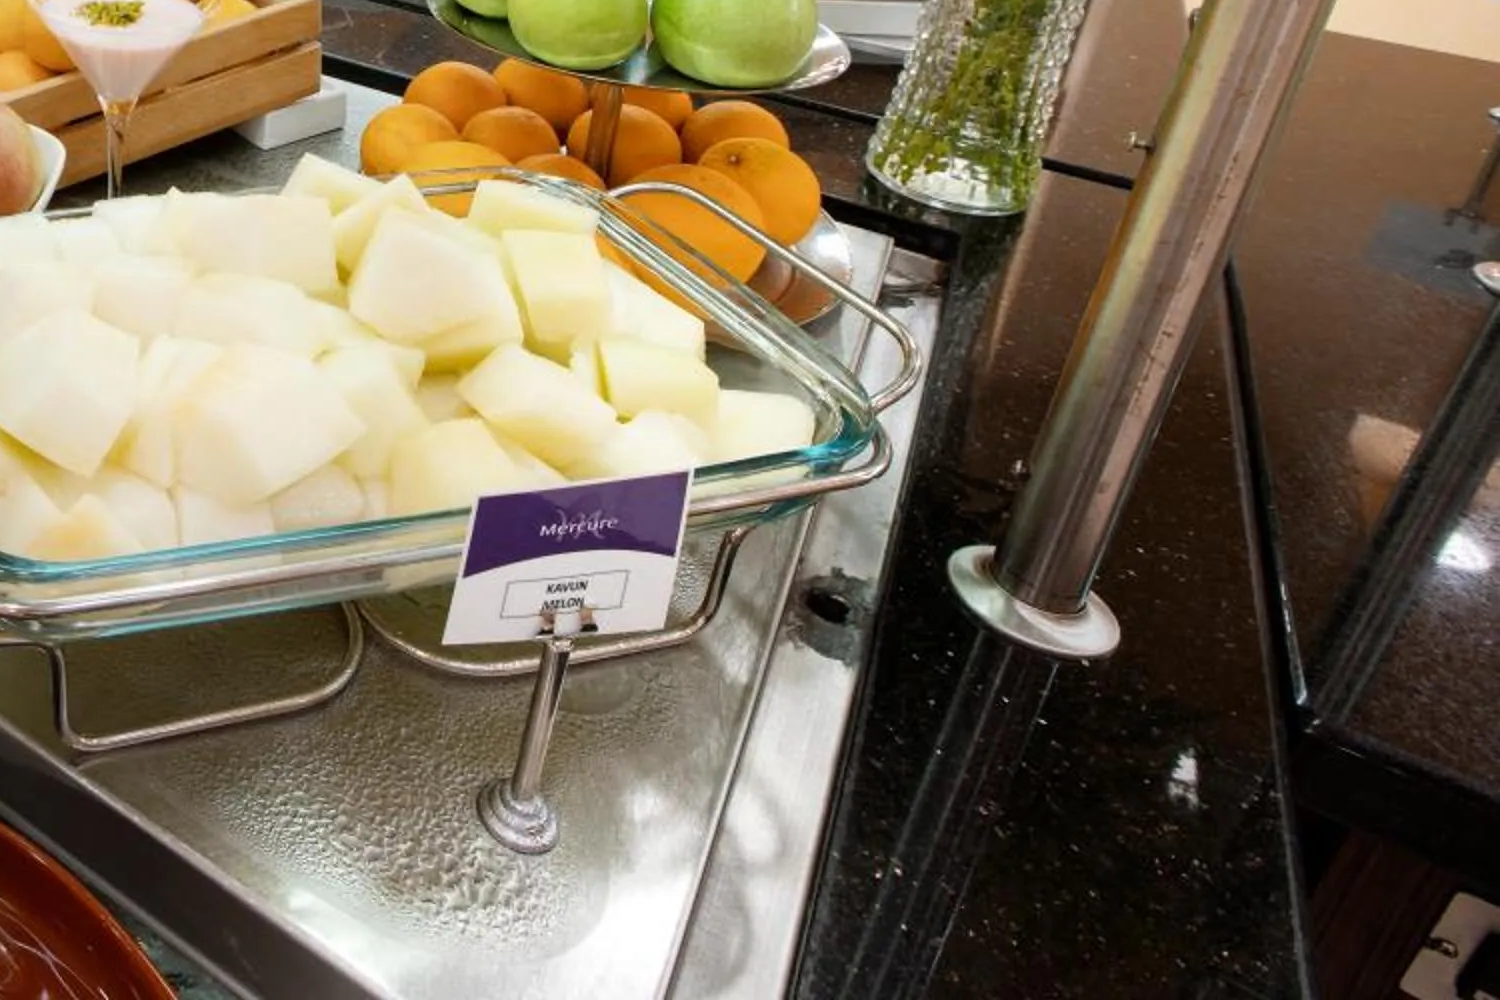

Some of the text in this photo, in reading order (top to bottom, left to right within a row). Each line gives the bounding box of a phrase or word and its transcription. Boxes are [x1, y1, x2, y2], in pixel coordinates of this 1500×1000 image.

[540, 517, 618, 537] Mercure
[546, 580, 588, 594] KAVUN
[540, 597, 585, 611] MELON
